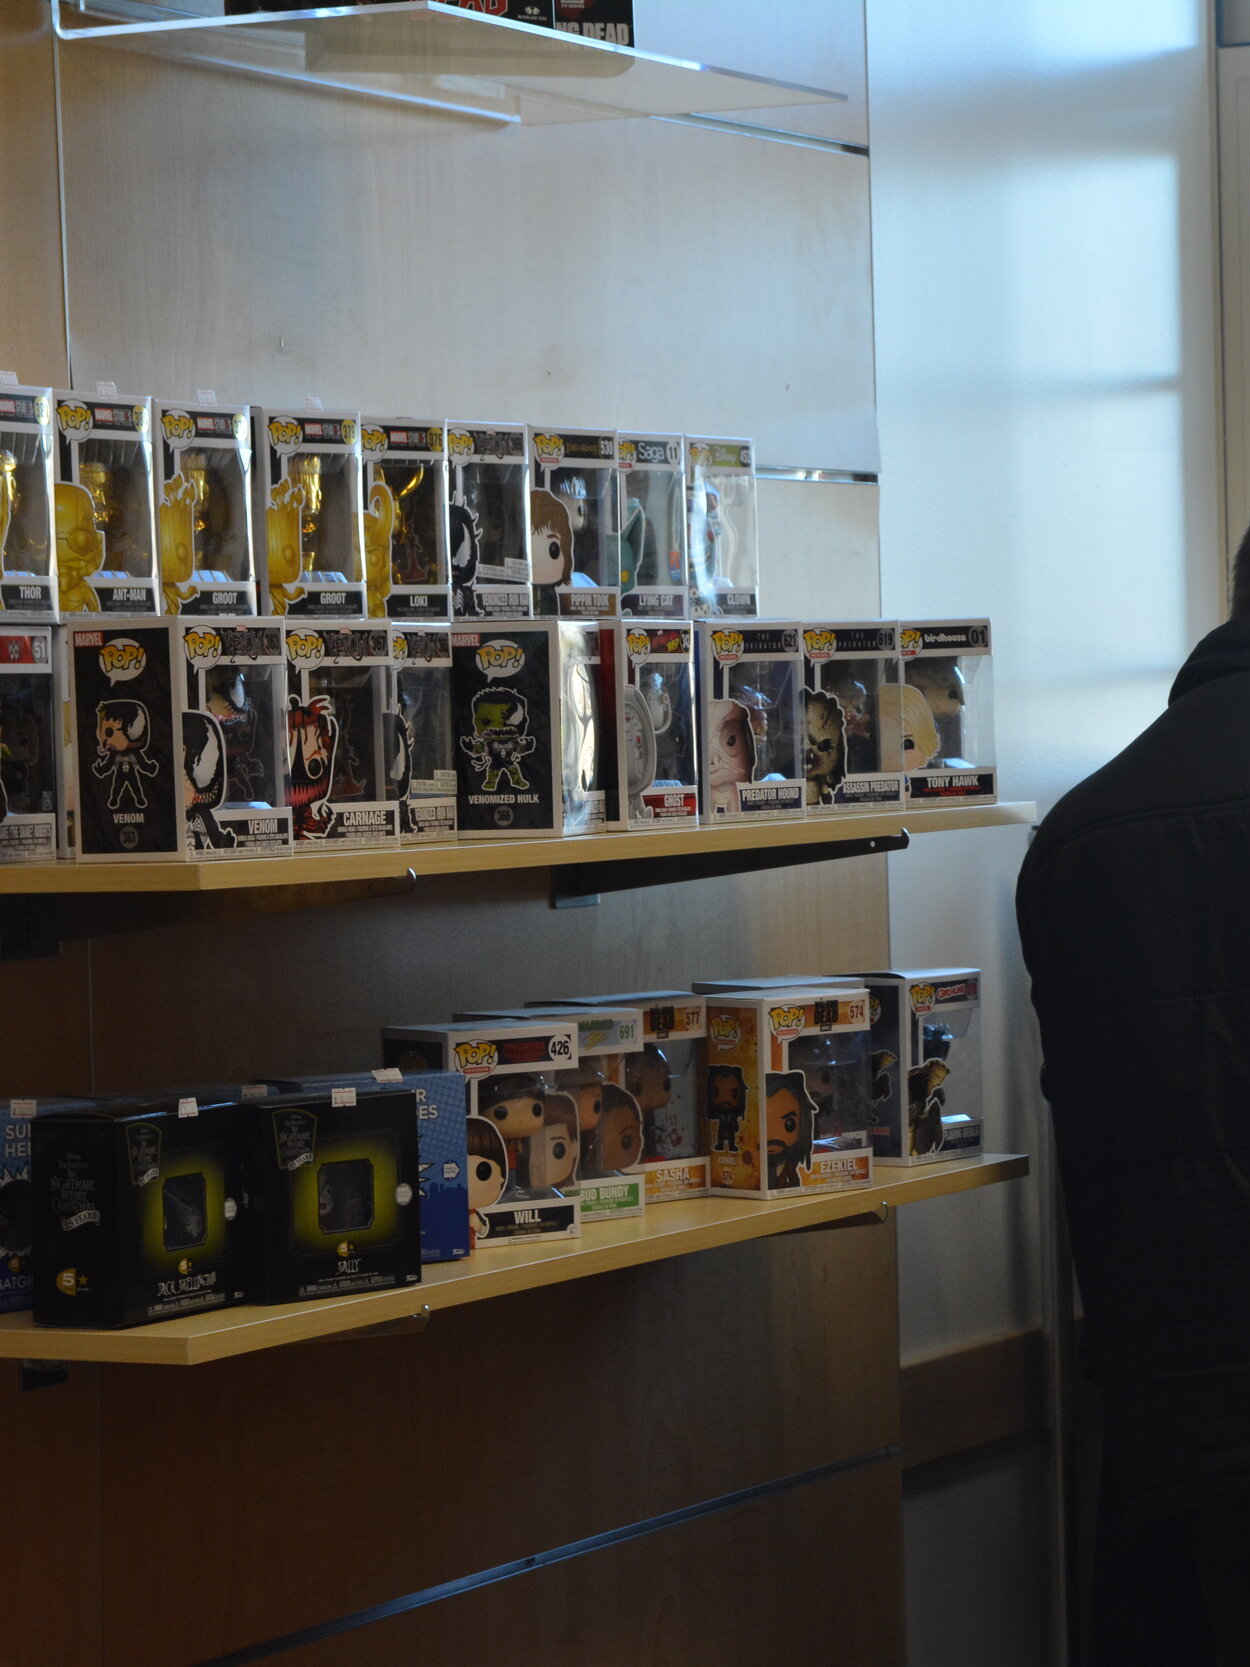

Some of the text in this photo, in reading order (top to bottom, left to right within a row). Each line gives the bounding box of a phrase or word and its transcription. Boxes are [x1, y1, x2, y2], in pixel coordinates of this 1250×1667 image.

[56, 405, 92, 431] POP!
[160, 415, 195, 439] POP!
[267, 421, 302, 446] POP!
[533, 433, 563, 456] POP!
[618, 441, 635, 459] OP!
[638, 442, 665, 463] Saga
[668, 443, 680, 459] 11
[19, 587, 42, 600] THOR
[112, 588, 147, 601] ANT-MAN
[212, 592, 238, 604] GROOT
[320, 592, 347, 604] GROOT
[409, 595, 429, 607] LOKI
[661, 595, 674, 606] CAT
[726, 594, 752, 605] CLOWN
[75, 632, 103, 648] MARVEL
[451, 633, 480, 646] MARVEL
[626, 633, 651, 655] POP!
[711, 631, 744, 653] POP!
[783, 634, 797, 649] 621
[803, 630, 837, 651] POP!
[878, 631, 894, 648] 619
[924, 633, 967, 643] birdhouse
[971, 629, 987, 644] 01
[34, 642, 46, 658] 51
[183, 632, 221, 659] POP!
[286, 635, 325, 660] POP!
[100, 645, 145, 672] POP!
[476, 645, 524, 670] POP!
[842, 780, 899, 794] ASSASSIN PREDATOR
[926, 775, 980, 788] TONY HAWK
[468, 793, 540, 805] VENOMIZED HULK
[664, 794, 685, 807] GHOST
[742, 786, 800, 802] PREDATOR HOUND
[113, 813, 144, 824] VENOM
[248, 819, 278, 834] VENOM
[343, 811, 386, 826] CARNAGE
[910, 984, 936, 1005] POP!
[685, 1012, 699, 1026] 577
[768, 1008, 805, 1030] POP!
[849, 1007, 863, 1019] 574
[620, 1025, 634, 1039] 691
[708, 1017, 741, 1036] POP!
[454, 1042, 497, 1068] POP!
[551, 1041, 570, 1056] 426
[820, 1160, 859, 1172] EZEKIEL
[656, 1167, 690, 1183] SASHA
[580, 1185, 629, 1201] BUD BUNDY
[514, 1209, 542, 1225] WILL
[336, 1258, 362, 1275] SALLY
[157, 1281, 176, 1298] JACK
